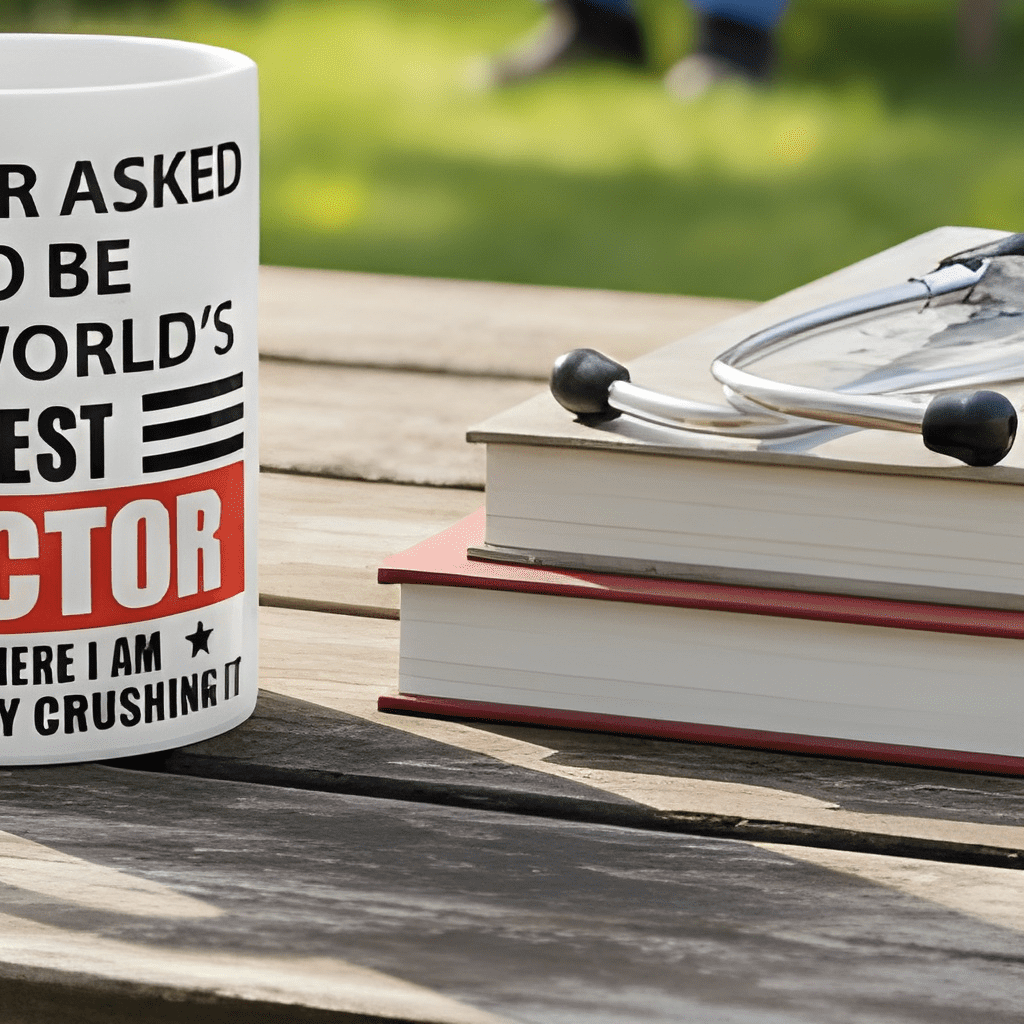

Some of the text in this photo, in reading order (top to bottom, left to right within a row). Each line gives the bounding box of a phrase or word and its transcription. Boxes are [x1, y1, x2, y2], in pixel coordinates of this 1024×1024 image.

[60, 142, 242, 216] ASKED
[49, 239, 132, 298] BE
[88, 641, 98, 681] I
[110, 631, 162, 678] AM
[33, 668, 218, 736] CRUSHING
[223, 656, 243, 701] IT
